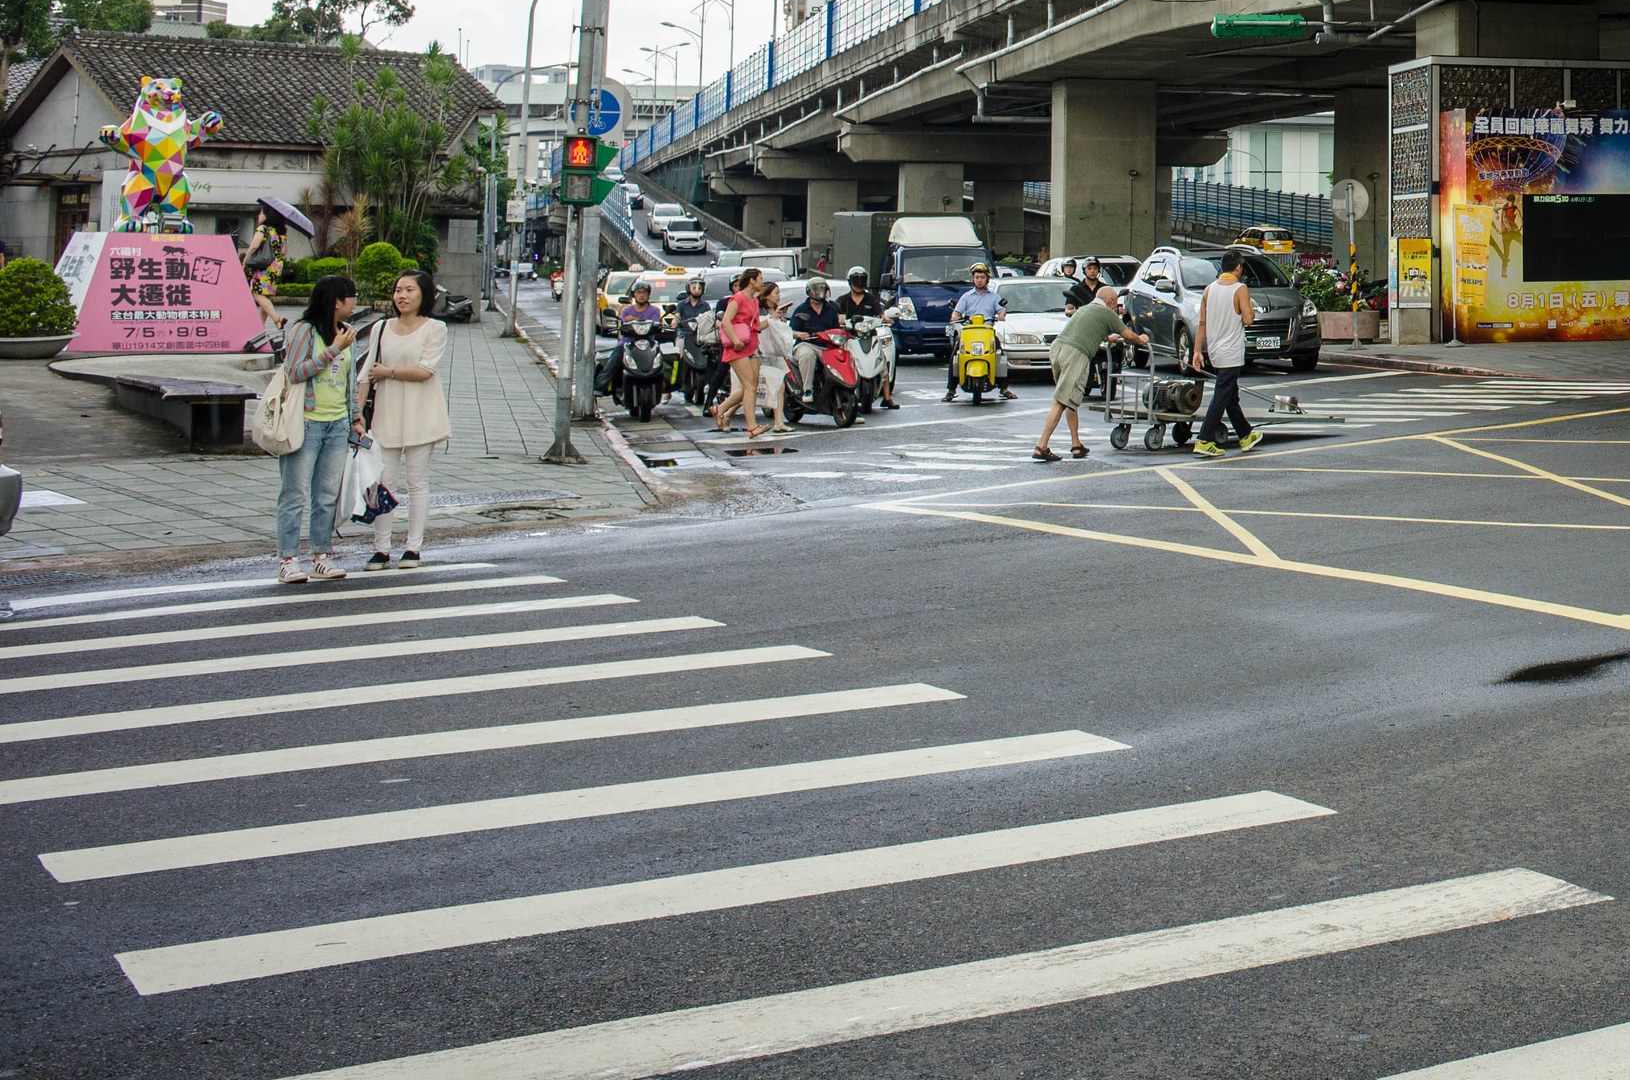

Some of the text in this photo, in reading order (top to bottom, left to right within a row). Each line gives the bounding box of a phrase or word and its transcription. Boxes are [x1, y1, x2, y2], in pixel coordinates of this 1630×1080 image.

[1474, 116, 1594, 136] 全員回歸華麗舞秀
[110, 247, 142, 256] 六福村
[110, 256, 223, 285] 野生動物
[111, 284, 192, 306] 大遷徙
[111, 311, 220, 320] 全台最大動物標本特展
